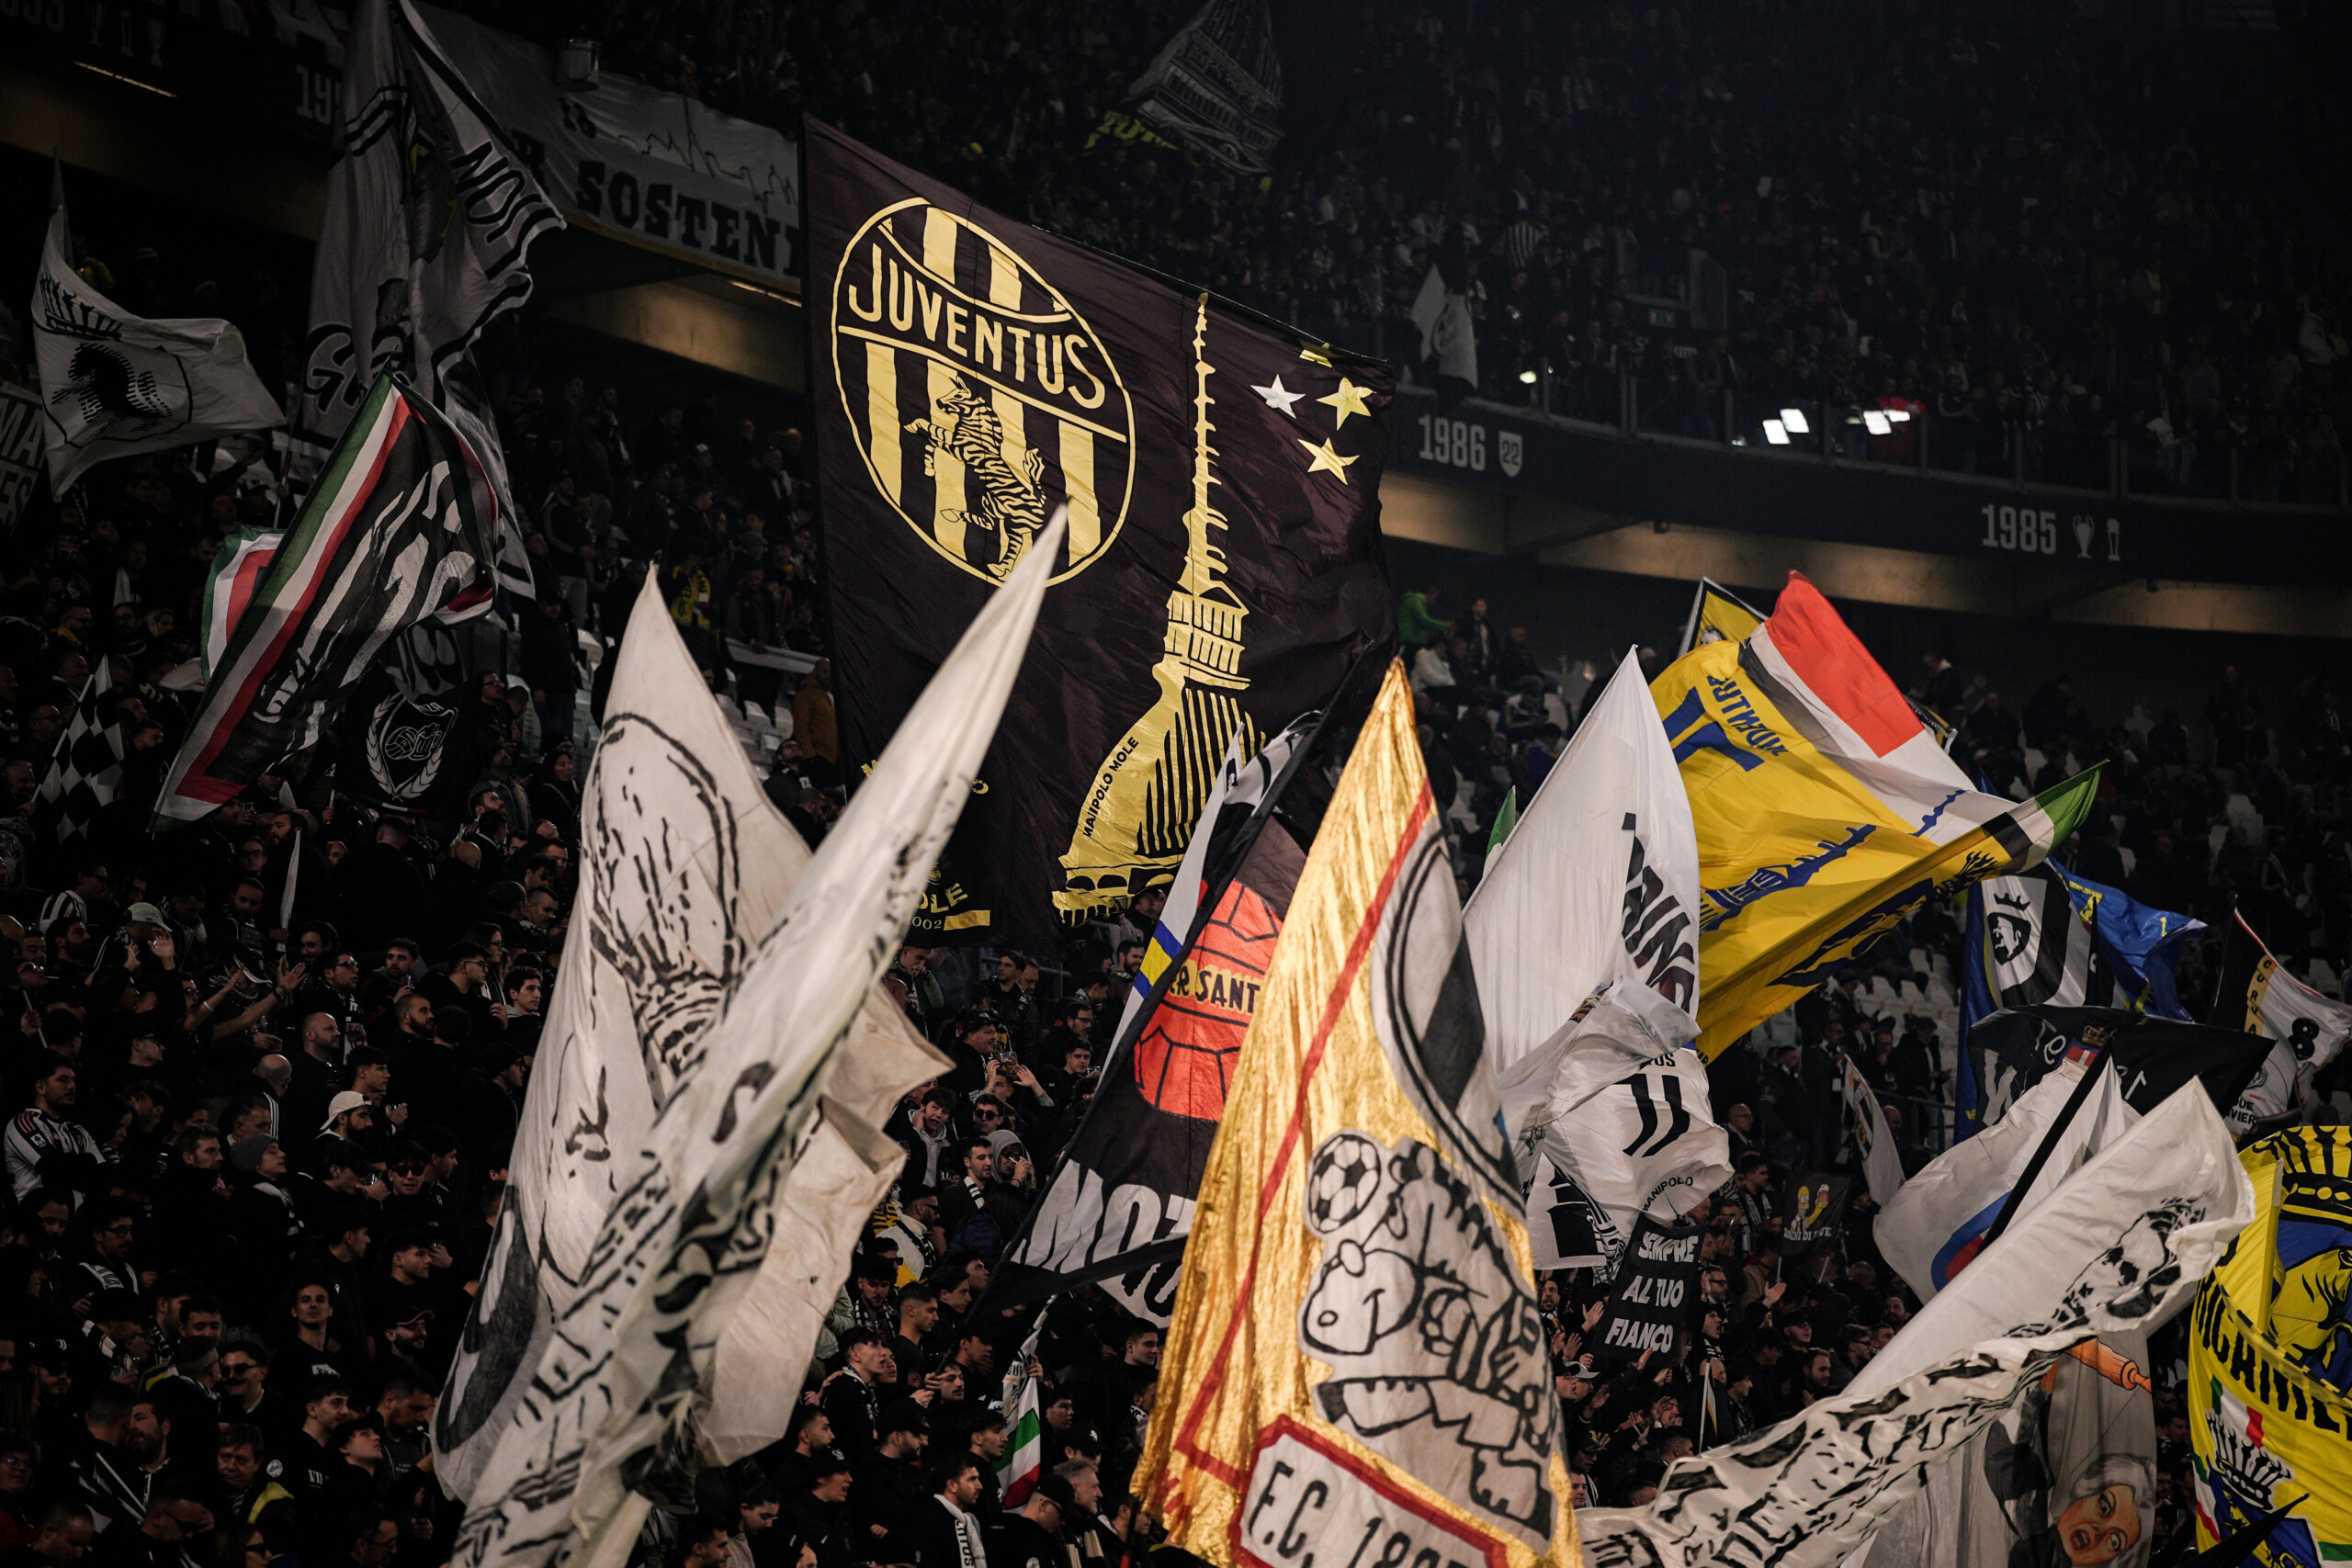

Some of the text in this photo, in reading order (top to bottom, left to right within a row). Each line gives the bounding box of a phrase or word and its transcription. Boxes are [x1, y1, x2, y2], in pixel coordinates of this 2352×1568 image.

[296, 64, 341, 125] 19
[847, 242, 1106, 411] JUVENTUS
[1418, 413, 1519, 472] 1986 22
[1981, 502, 2057, 555] 1985
[1108, 736, 1138, 772] MOLE
[2246, 960, 2272, 1034] CURVA
[1637, 1231, 1699, 1263] SEMPRE
[1622, 1274, 1685, 1308] AL TUO
[1604, 1317, 1674, 1354] FIANCO
